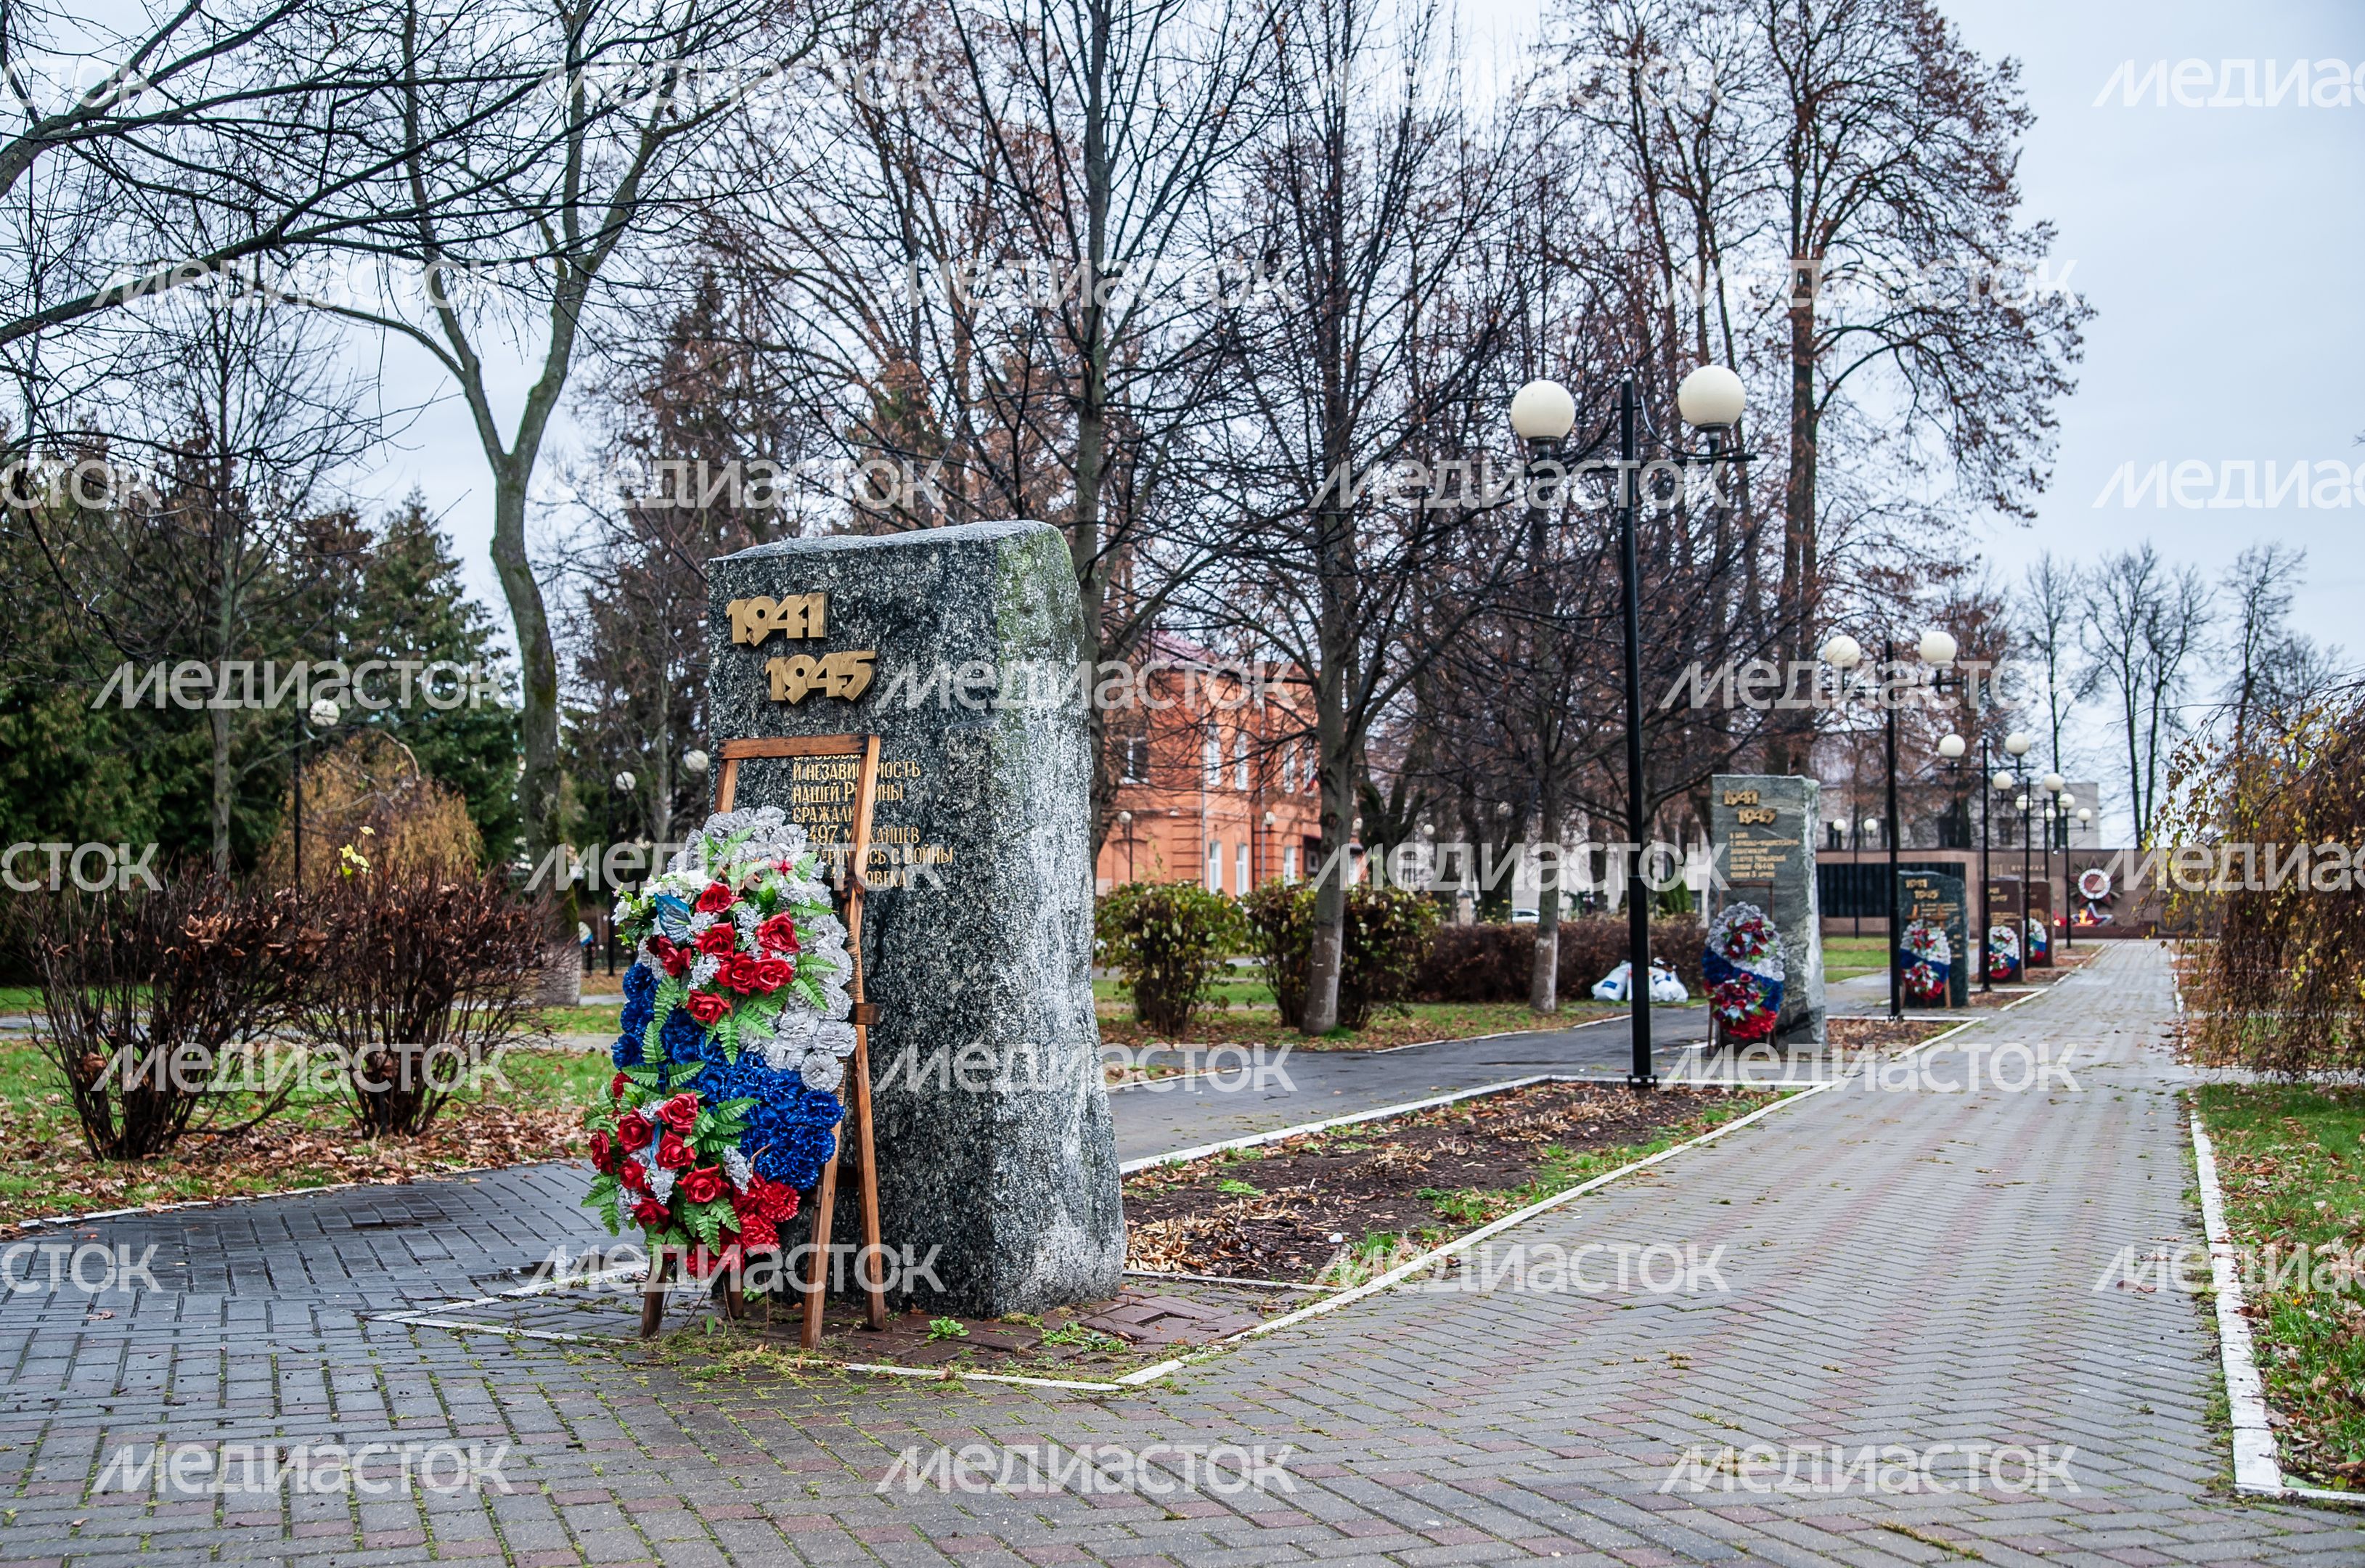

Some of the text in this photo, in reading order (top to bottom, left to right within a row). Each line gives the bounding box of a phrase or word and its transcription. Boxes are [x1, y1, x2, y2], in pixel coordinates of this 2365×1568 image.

[727, 592, 829, 647] 1941
[766, 650, 877, 705] 1945
[806, 761, 920, 780] НЕЗАВИМОСТЬ
[793, 781, 903, 804] НАШЕЙ РИНЫ
[1723, 789, 1760, 806] 1941
[1737, 808, 1777, 825] 1945
[904, 844, 953, 865] ВОЙНЫ
